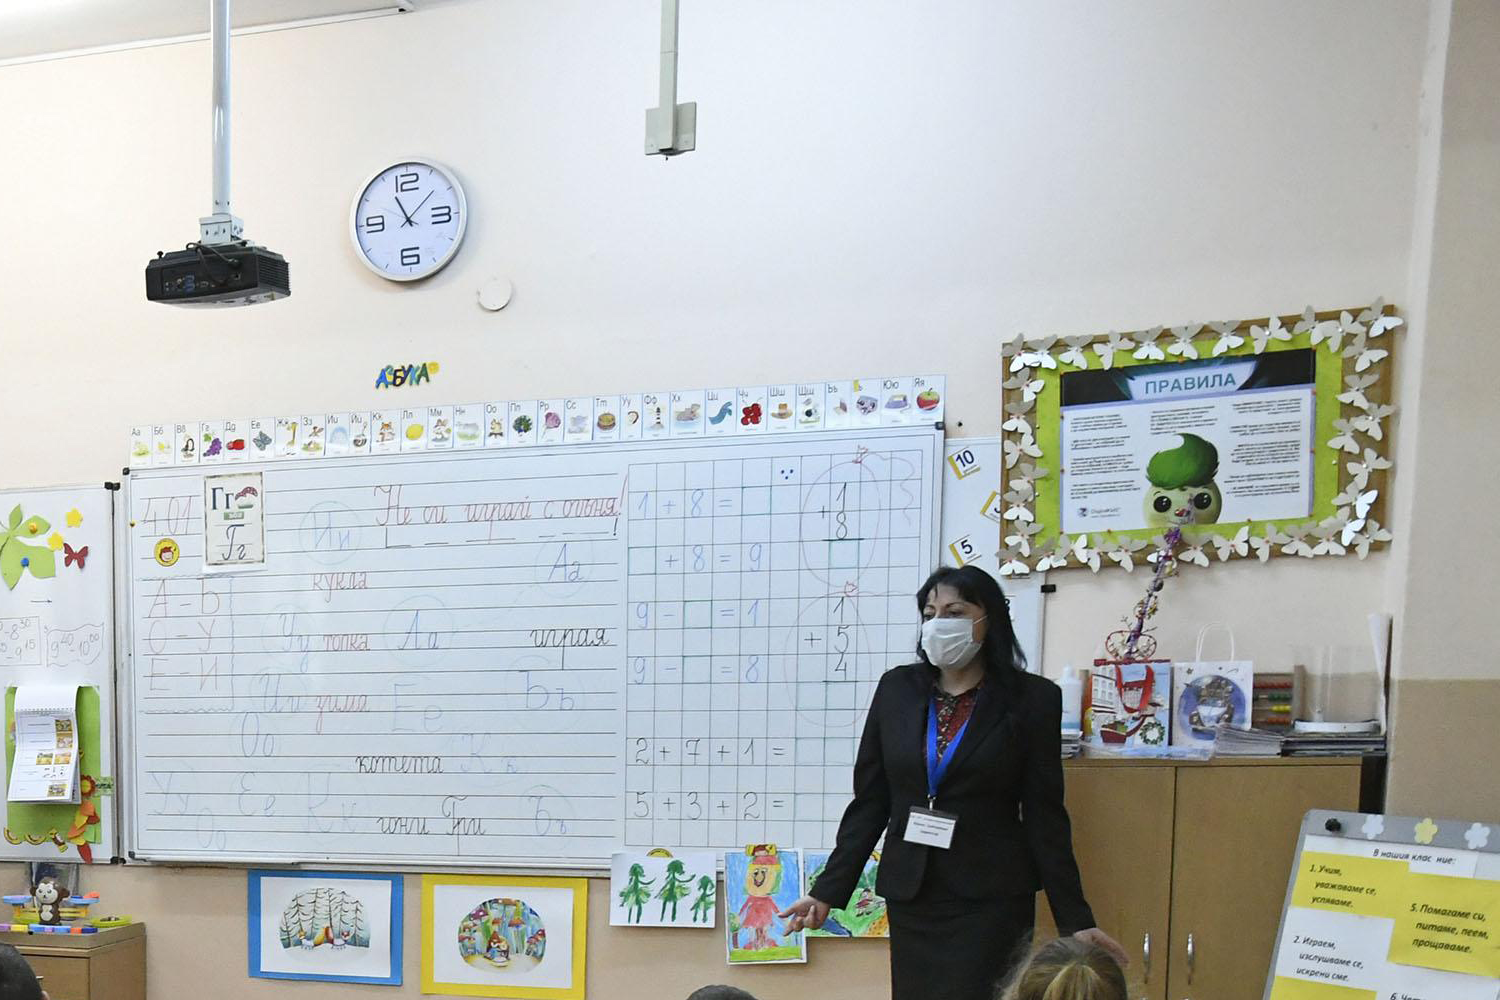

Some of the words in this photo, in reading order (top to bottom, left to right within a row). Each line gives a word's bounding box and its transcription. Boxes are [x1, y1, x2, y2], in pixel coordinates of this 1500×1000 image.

[395, 173, 419, 193] 12
[366, 215, 385, 234] 9
[431, 205, 452, 225] 3
[400, 246, 420, 266] 6
[1144, 373, 1237, 395] ПРАВИЛА
[955, 450, 975, 468] 10
[211, 486, 235, 511] Гг
[637, 492, 649, 520] 1
[691, 488, 704, 518] 8
[836, 482, 847, 512] 1
[836, 511, 848, 540] 8
[222, 523, 247, 561] Гг
[961, 539, 973, 555] 5
[692, 544, 705, 572] 8
[749, 542, 762, 572] 9
[636, 601, 649, 629] 9
[747, 600, 759, 627] 1
[833, 596, 845, 624] 1
[834, 625, 850, 653] 5
[633, 656, 646, 685] 9
[745, 655, 759, 683] 8
[834, 652, 847, 681] 4
[635, 737, 651, 765] 2
[686, 738, 701, 766] 7
[744, 738, 755, 765] 1
[634, 791, 650, 818] 5
[686, 791, 702, 820] 3
[743, 791, 760, 820] 2
